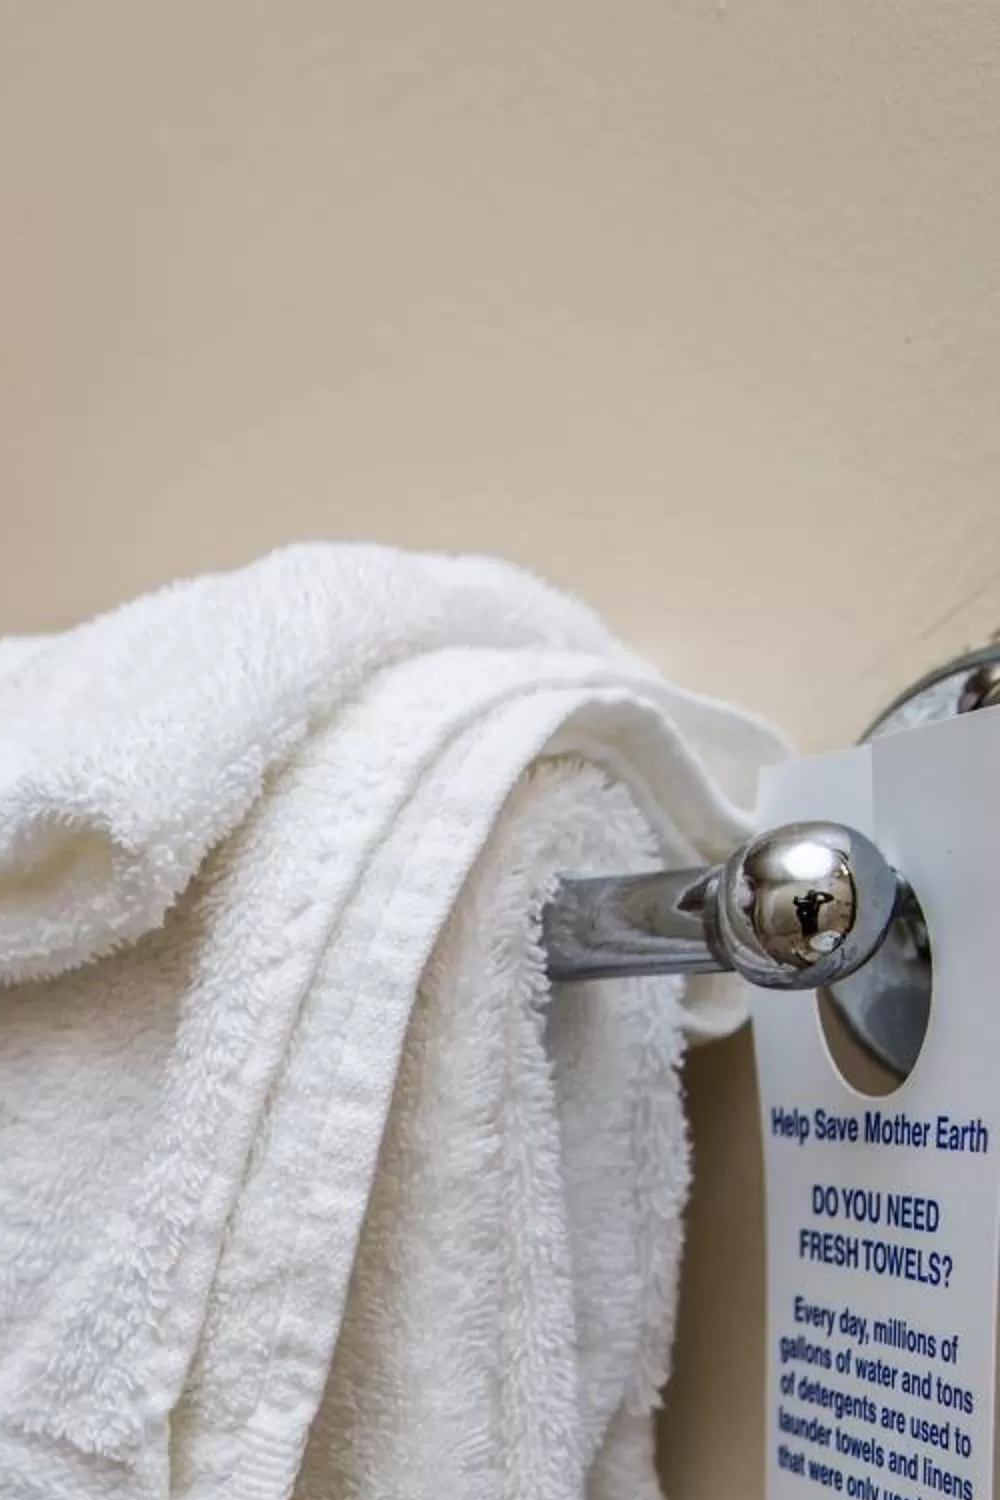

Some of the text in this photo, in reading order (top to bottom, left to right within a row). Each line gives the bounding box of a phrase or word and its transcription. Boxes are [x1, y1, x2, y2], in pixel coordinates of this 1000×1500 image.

[771, 1107, 988, 1153] Help Save Mother Earth
[812, 1185, 939, 1232] DO YOU NEED
[800, 1229, 953, 1287] FRESH TOWELS?
[794, 1296, 959, 1363] Every day, millions of
[780, 1335, 973, 1414] gallons of water and tons
[778, 1405, 831, 1446] launder
[835, 1428, 884, 1468] towels
[888, 1452, 918, 1480] and
[780, 1372, 971, 1457] of detergents are used to
[778, 1445, 805, 1476] that
[809, 1460, 842, 1491] were
